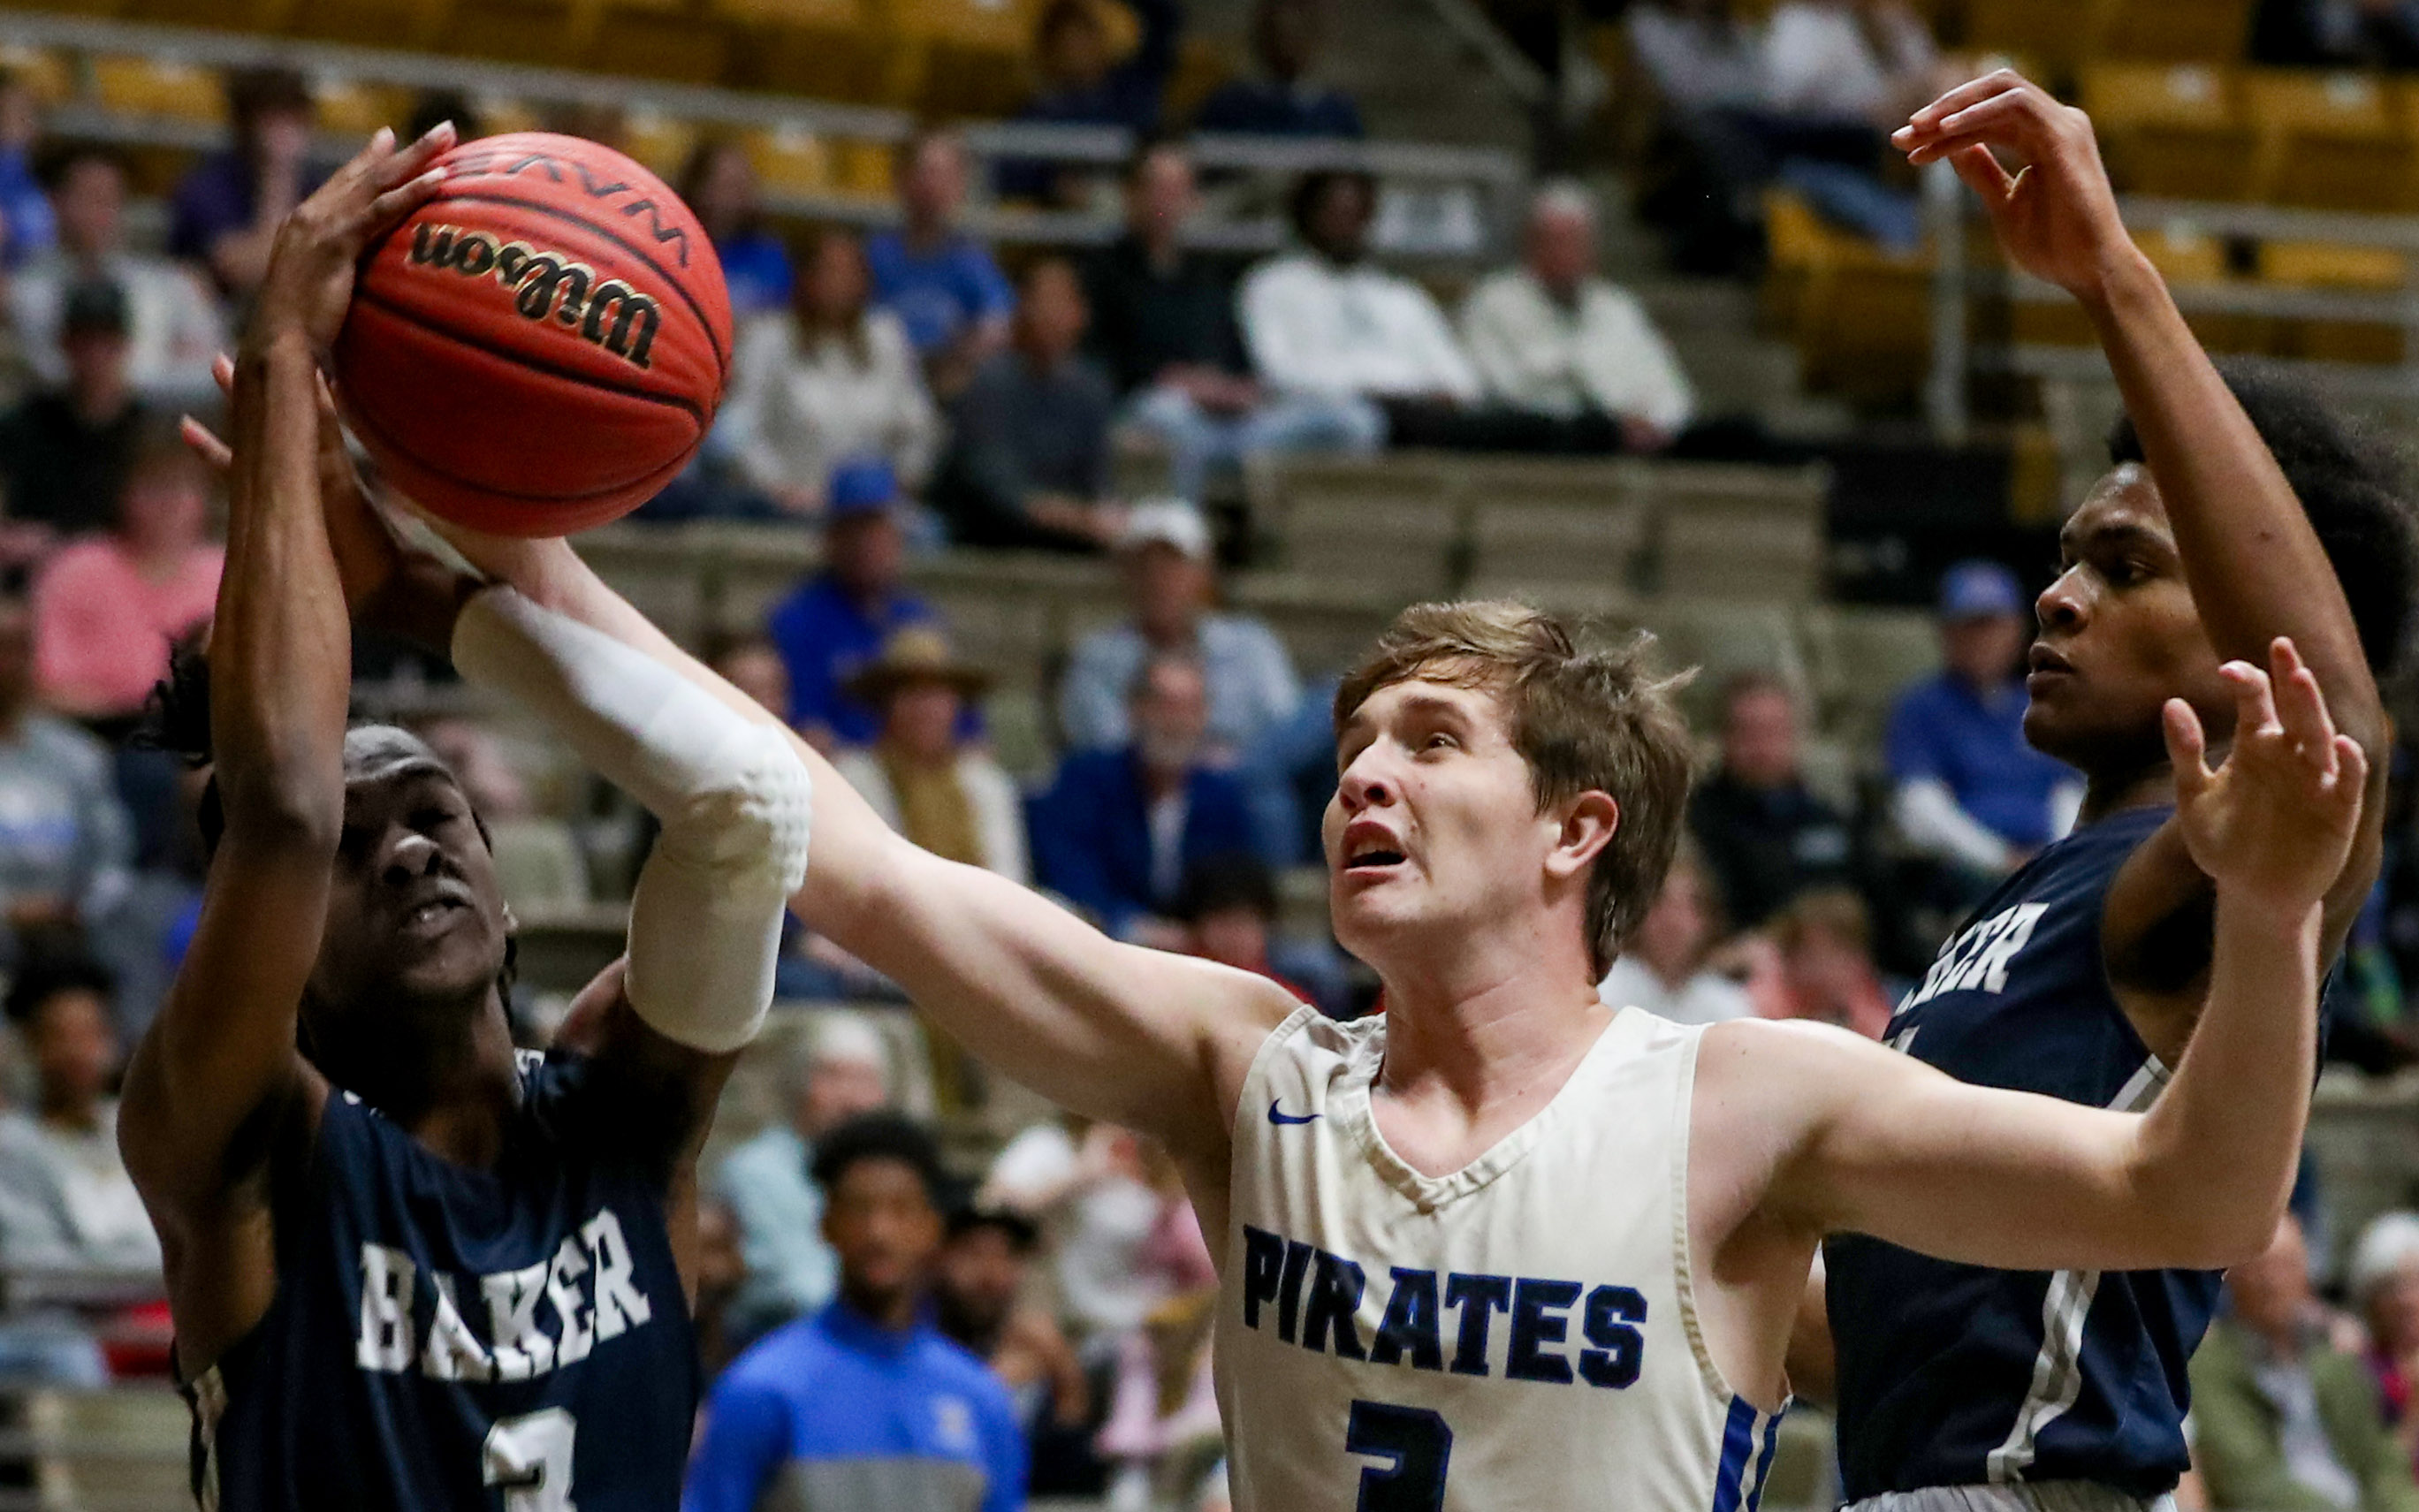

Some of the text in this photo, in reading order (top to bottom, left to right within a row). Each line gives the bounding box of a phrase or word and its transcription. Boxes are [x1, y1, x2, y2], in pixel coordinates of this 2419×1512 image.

[406, 222, 660, 370] Wilson
[355, 1206, 651, 1383] BAKER
[1243, 1223, 1648, 1390] PIRATES
